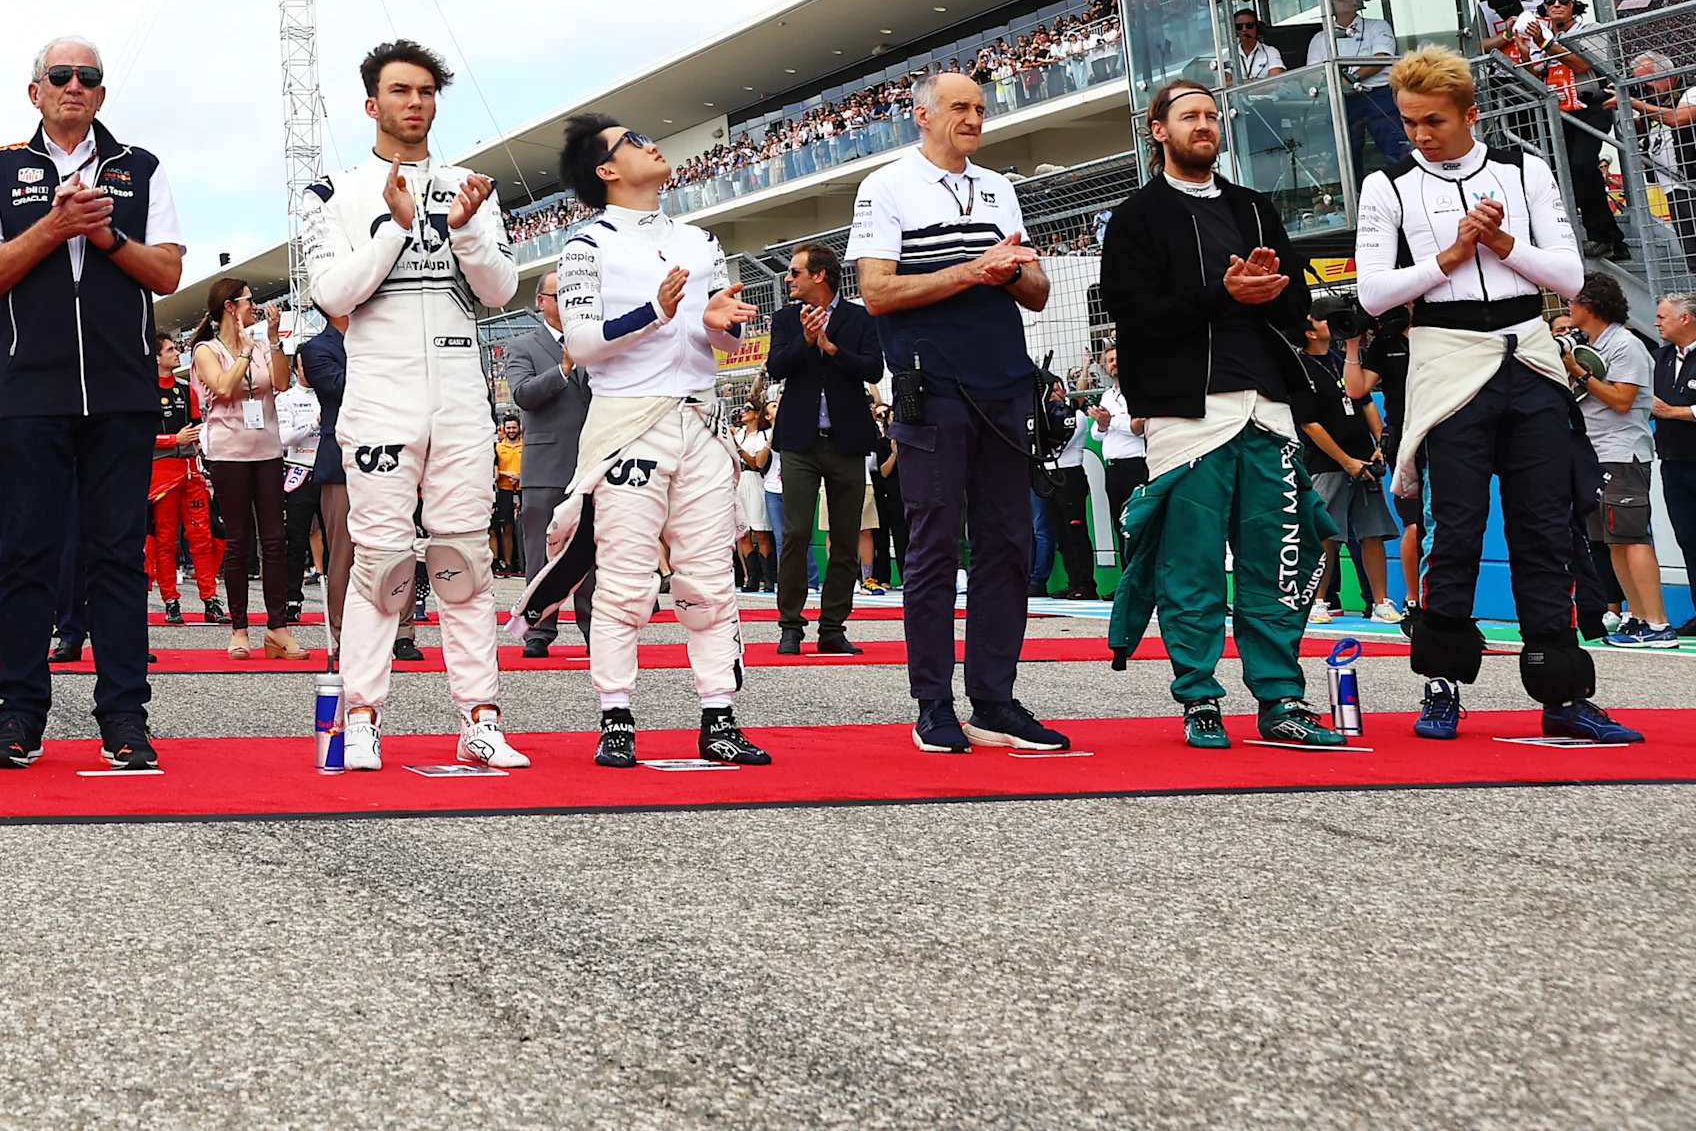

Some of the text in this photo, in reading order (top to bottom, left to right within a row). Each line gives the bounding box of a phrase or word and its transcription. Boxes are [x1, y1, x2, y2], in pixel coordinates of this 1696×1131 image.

[12, 185, 38, 198] Mobil
[108, 185, 134, 198] Tezos
[12, 195, 49, 206] ORACLE
[565, 268, 599, 278] randstad
[565, 295, 594, 309] HRC
[1278, 523, 1301, 611] ASTON
